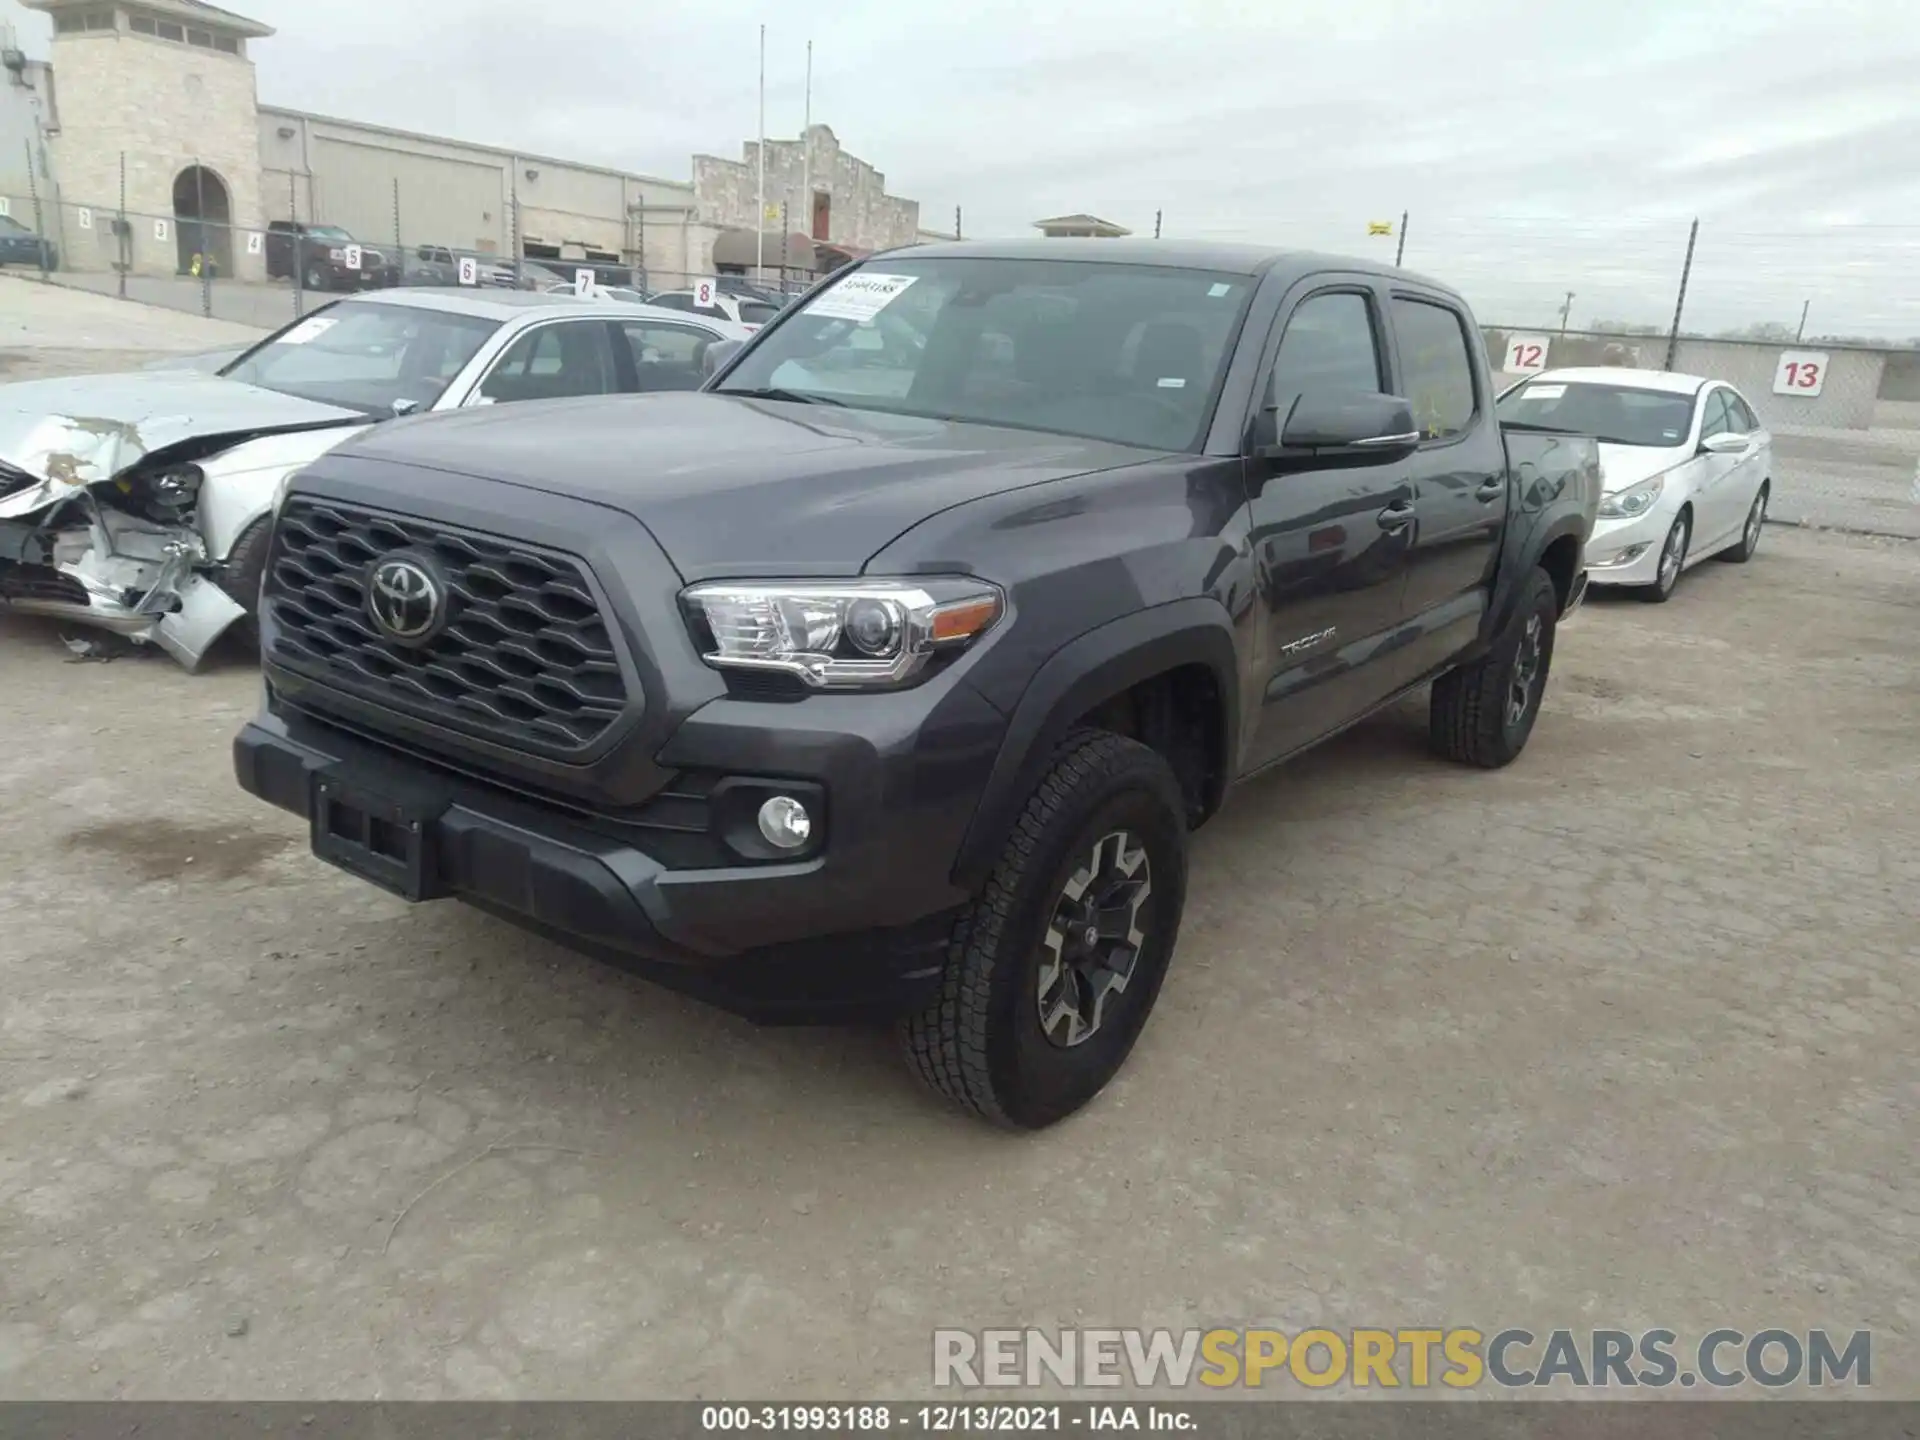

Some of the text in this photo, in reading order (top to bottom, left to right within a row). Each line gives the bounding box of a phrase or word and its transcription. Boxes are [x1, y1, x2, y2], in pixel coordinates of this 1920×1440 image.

[81, 211, 89, 227] 2
[250, 236, 258, 249] 4
[349, 249, 357, 265] 5
[463, 263, 472, 280] 6
[580, 274, 590, 293] 7
[700, 283, 710, 302] 8
[1512, 344, 1543, 368] 12
[1784, 361, 1820, 388] 13
